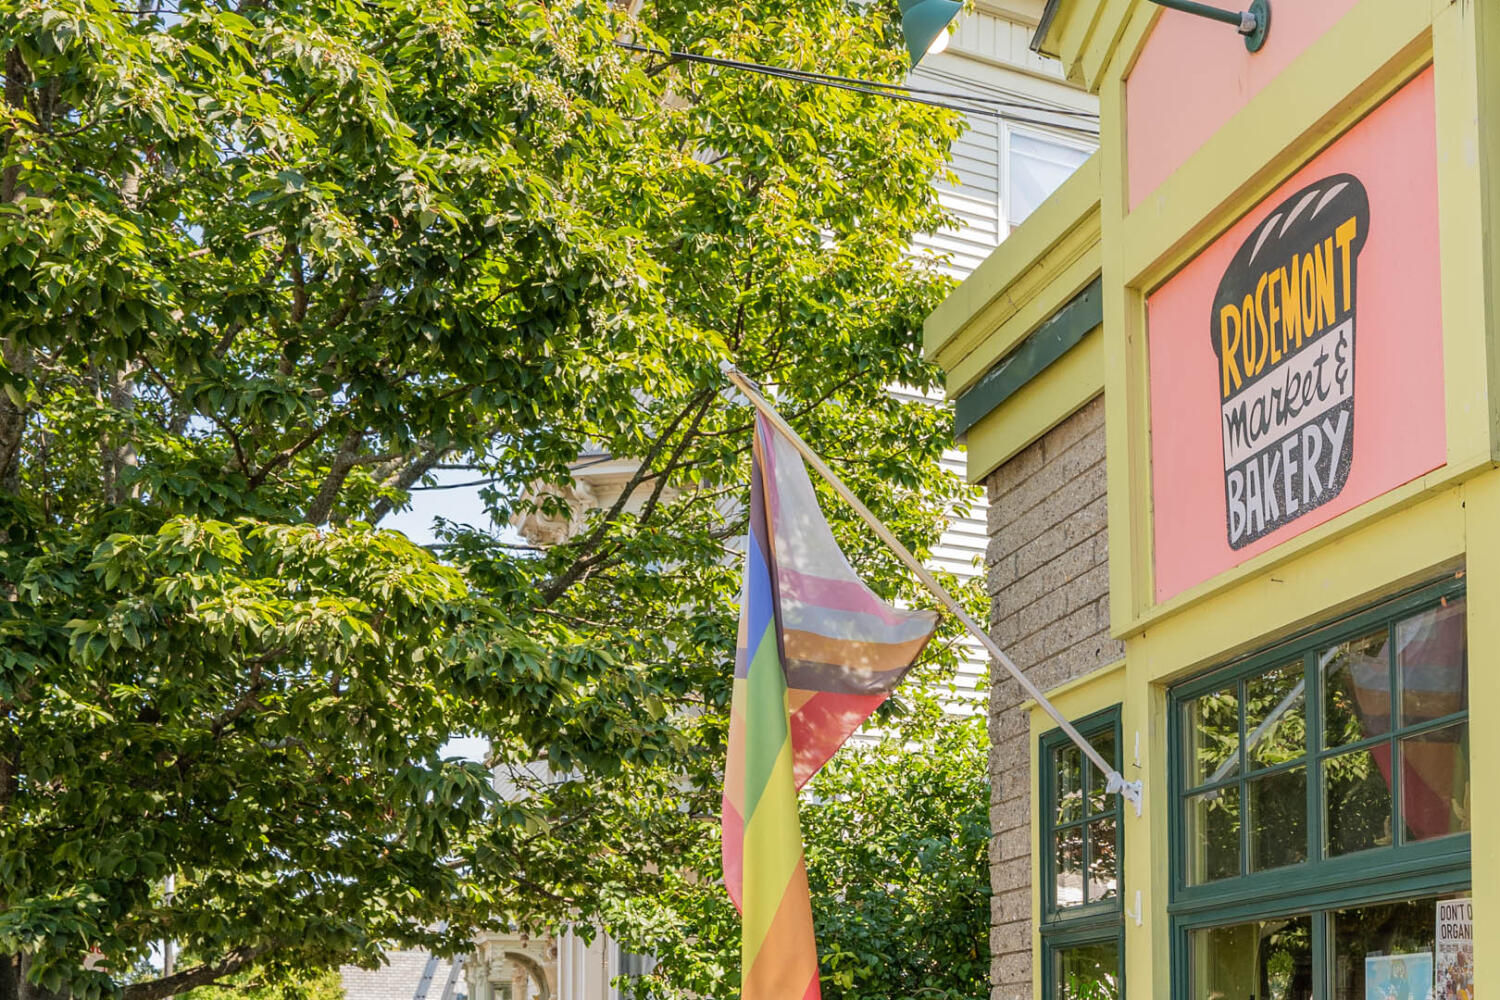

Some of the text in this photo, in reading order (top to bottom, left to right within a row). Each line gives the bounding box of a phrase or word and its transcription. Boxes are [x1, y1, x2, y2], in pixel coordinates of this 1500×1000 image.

[1220, 216, 1356, 397] ROSEMONT
[1335, 330, 1348, 395] &
[1228, 409, 1349, 543] BAKERY
[1441, 904, 1464, 921] DON'T
[1441, 924, 1473, 940] ORGANI
